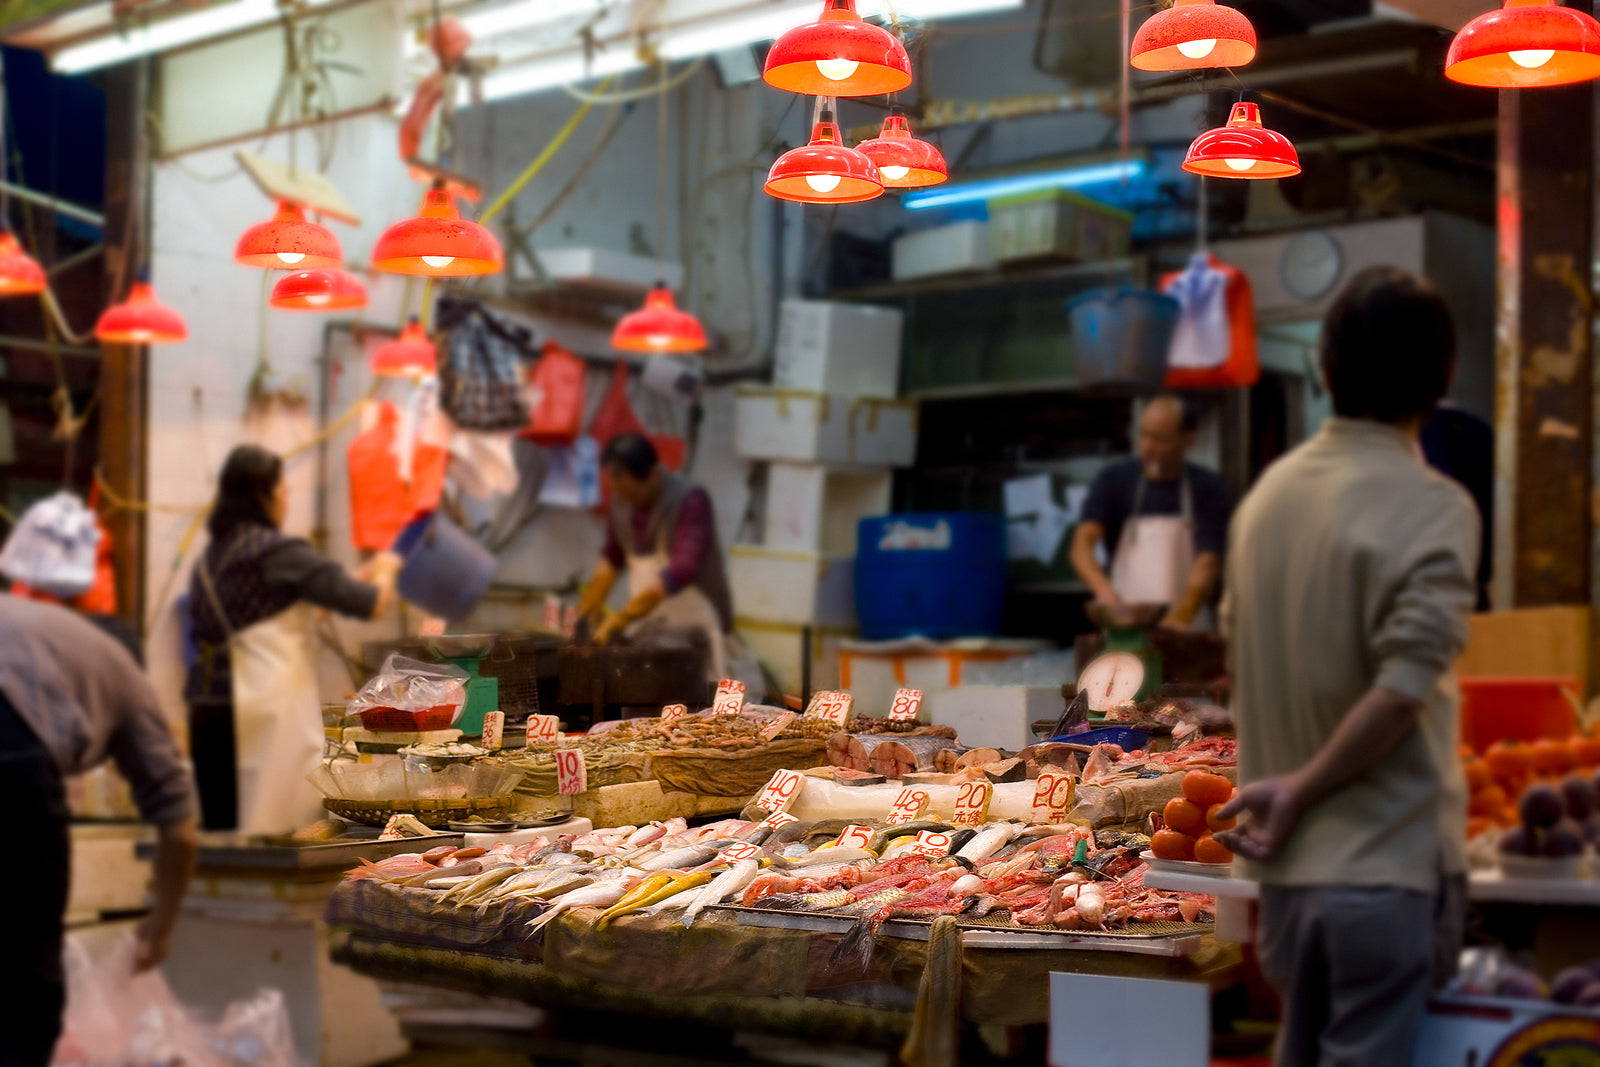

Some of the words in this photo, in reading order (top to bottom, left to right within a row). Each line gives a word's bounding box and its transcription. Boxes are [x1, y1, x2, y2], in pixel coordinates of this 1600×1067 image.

[822, 703, 842, 718] 72
[893, 697, 919, 714] 80
[526, 716, 555, 740] 24
[557, 752, 578, 779] 10
[767, 771, 799, 797] 40
[955, 783, 986, 808] 20
[1032, 774, 1071, 809] 20
[893, 789, 926, 812] 48
[834, 826, 872, 848] 15
[916, 830, 949, 846] 10
[722, 842, 758, 860] 20
